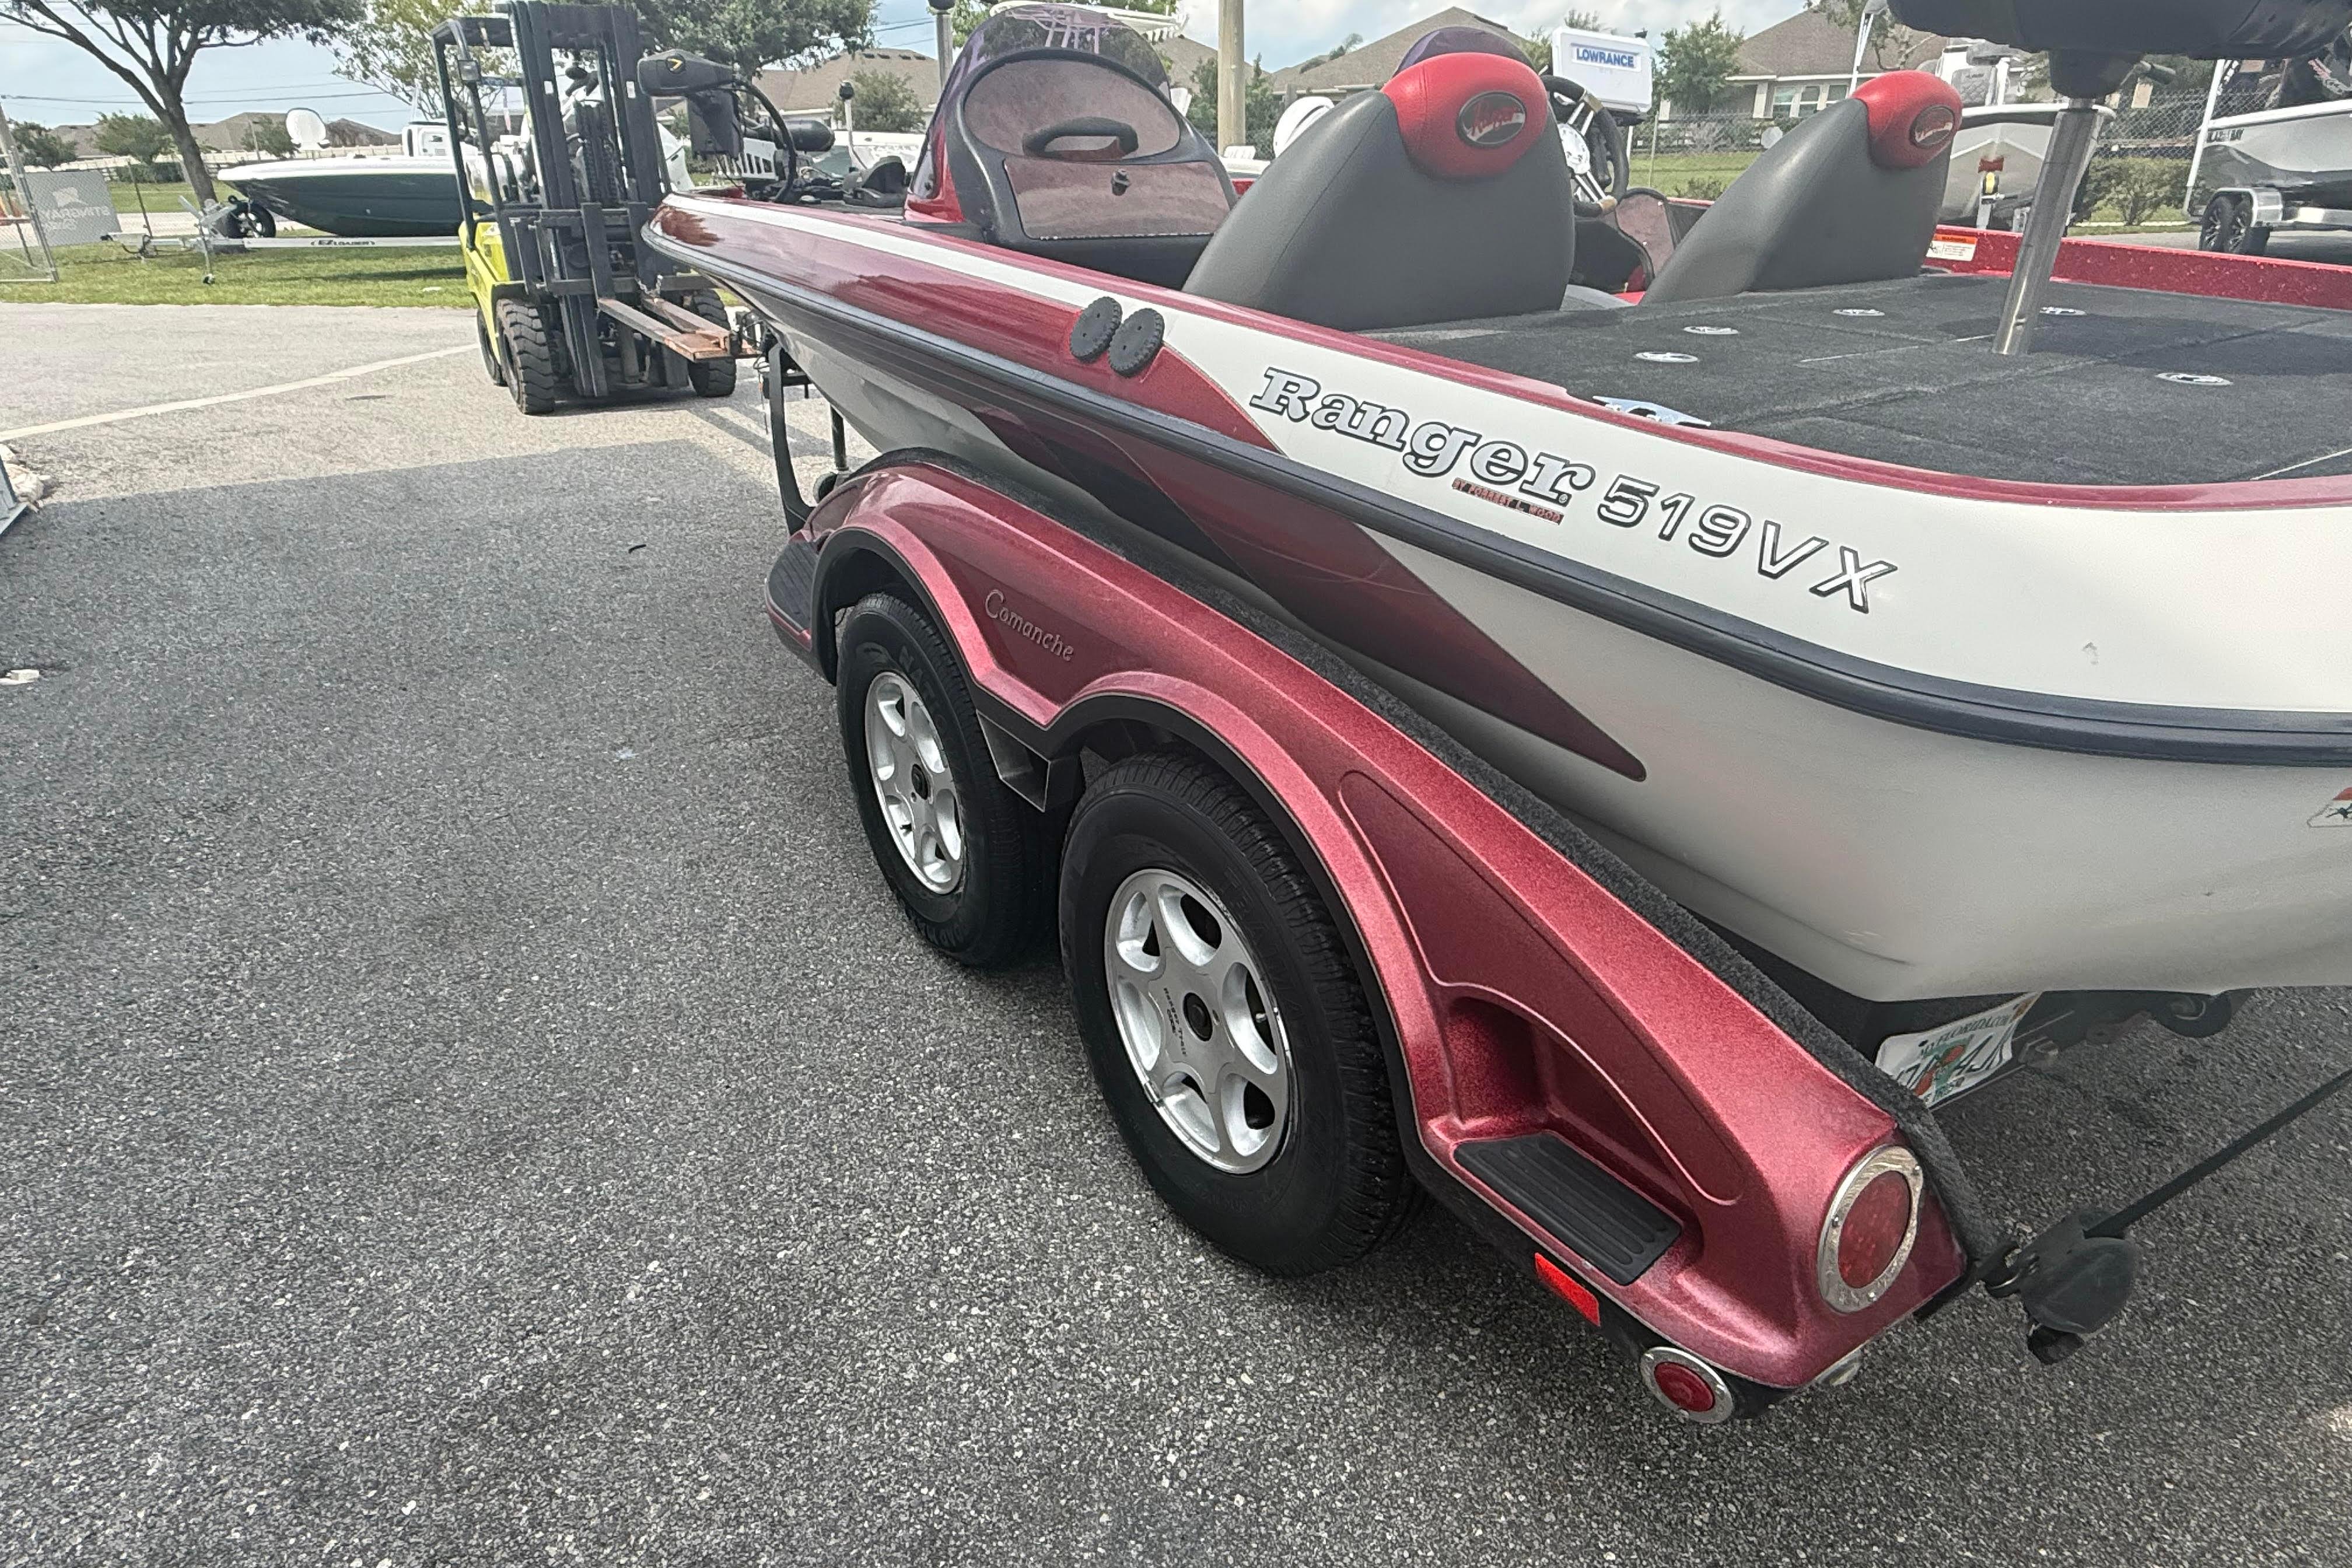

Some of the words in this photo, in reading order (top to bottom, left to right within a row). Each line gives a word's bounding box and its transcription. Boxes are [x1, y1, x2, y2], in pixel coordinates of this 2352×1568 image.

[1576, 48, 1635, 68] LOWRANCE
[1250, 366, 1595, 507] Ranger
[1529, 505, 1561, 523] WOOD
[985, 589, 1074, 661] Comanche
